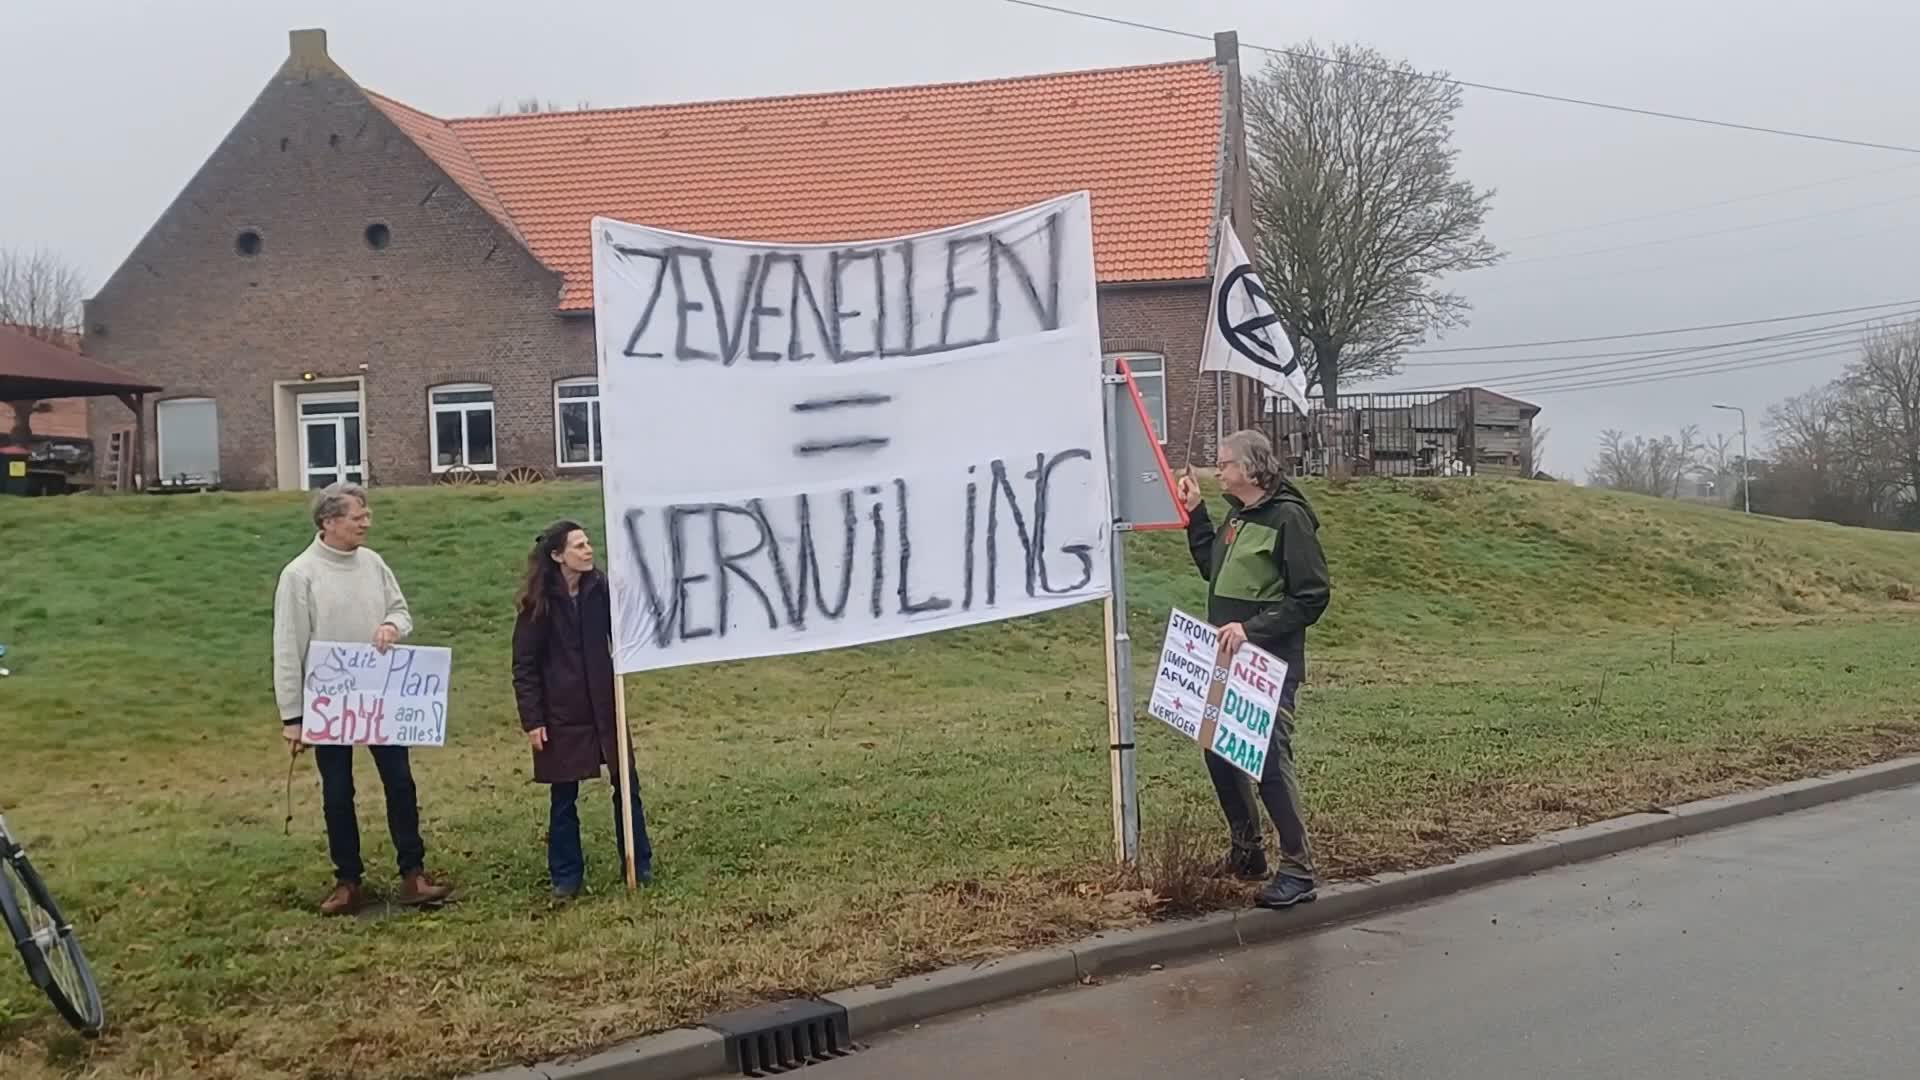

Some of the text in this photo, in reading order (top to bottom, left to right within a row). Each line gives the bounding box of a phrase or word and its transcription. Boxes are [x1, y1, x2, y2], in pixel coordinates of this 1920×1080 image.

[1172, 613, 1217, 648] STRONT
[382, 648, 441, 697] Plan
[1163, 648, 1210, 686] (IMPORT)
[1249, 651, 1270, 673] IS
[1161, 666, 1206, 699] AFVAL
[1233, 662, 1278, 698] NIET
[394, 707, 425, 722] aan
[1152, 702, 1198, 737] VERVOER
[1223, 688, 1271, 739] DUUR
[1214, 726, 1264, 777] ZAAM
